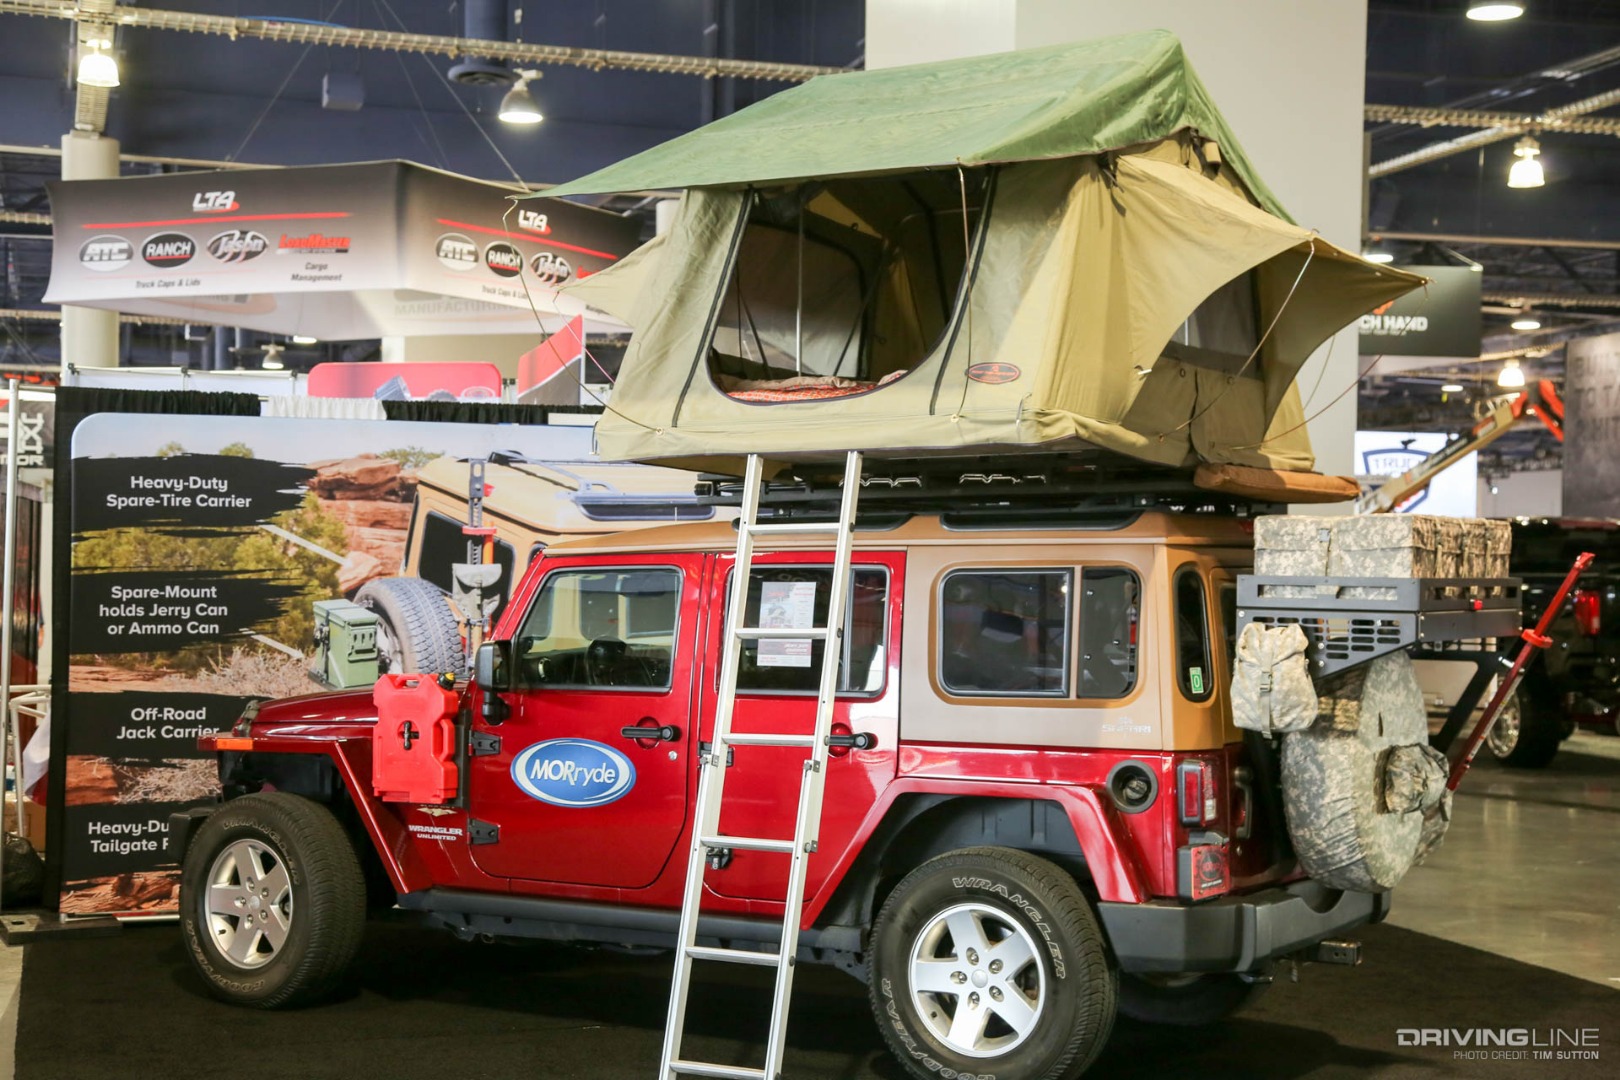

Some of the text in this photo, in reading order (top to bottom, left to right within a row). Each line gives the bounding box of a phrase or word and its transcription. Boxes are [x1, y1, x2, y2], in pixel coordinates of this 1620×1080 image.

[193, 190, 236, 209] LTA
[518, 209, 548, 232] LTA
[146, 241, 192, 257] RANCH
[305, 262, 328, 271] Cargo
[135, 280, 155, 289] Truck
[157, 279, 176, 289] Caps
[185, 277, 201, 287] Lids
[291, 273, 342, 283] Management
[130, 475, 229, 493] Heavy-Duty
[106, 493, 252, 510] Spare-Tire Carrier
[111, 585, 217, 601] Spare-Mount
[98, 603, 228, 619] holds Jerry Can
[107, 621, 219, 635] or Ammo Can
[130, 706, 207, 721] Off-Road
[116, 724, 220, 740] Jack Carrier
[529, 758, 617, 788] MORryde
[88, 820, 169, 837] Heavy-Du
[408, 824, 463, 837] WRANGLER
[416, 833, 457, 842] UNLIMITED
[90, 838, 158, 855] Tailgate
[952, 876, 1067, 980] WRANGLER
